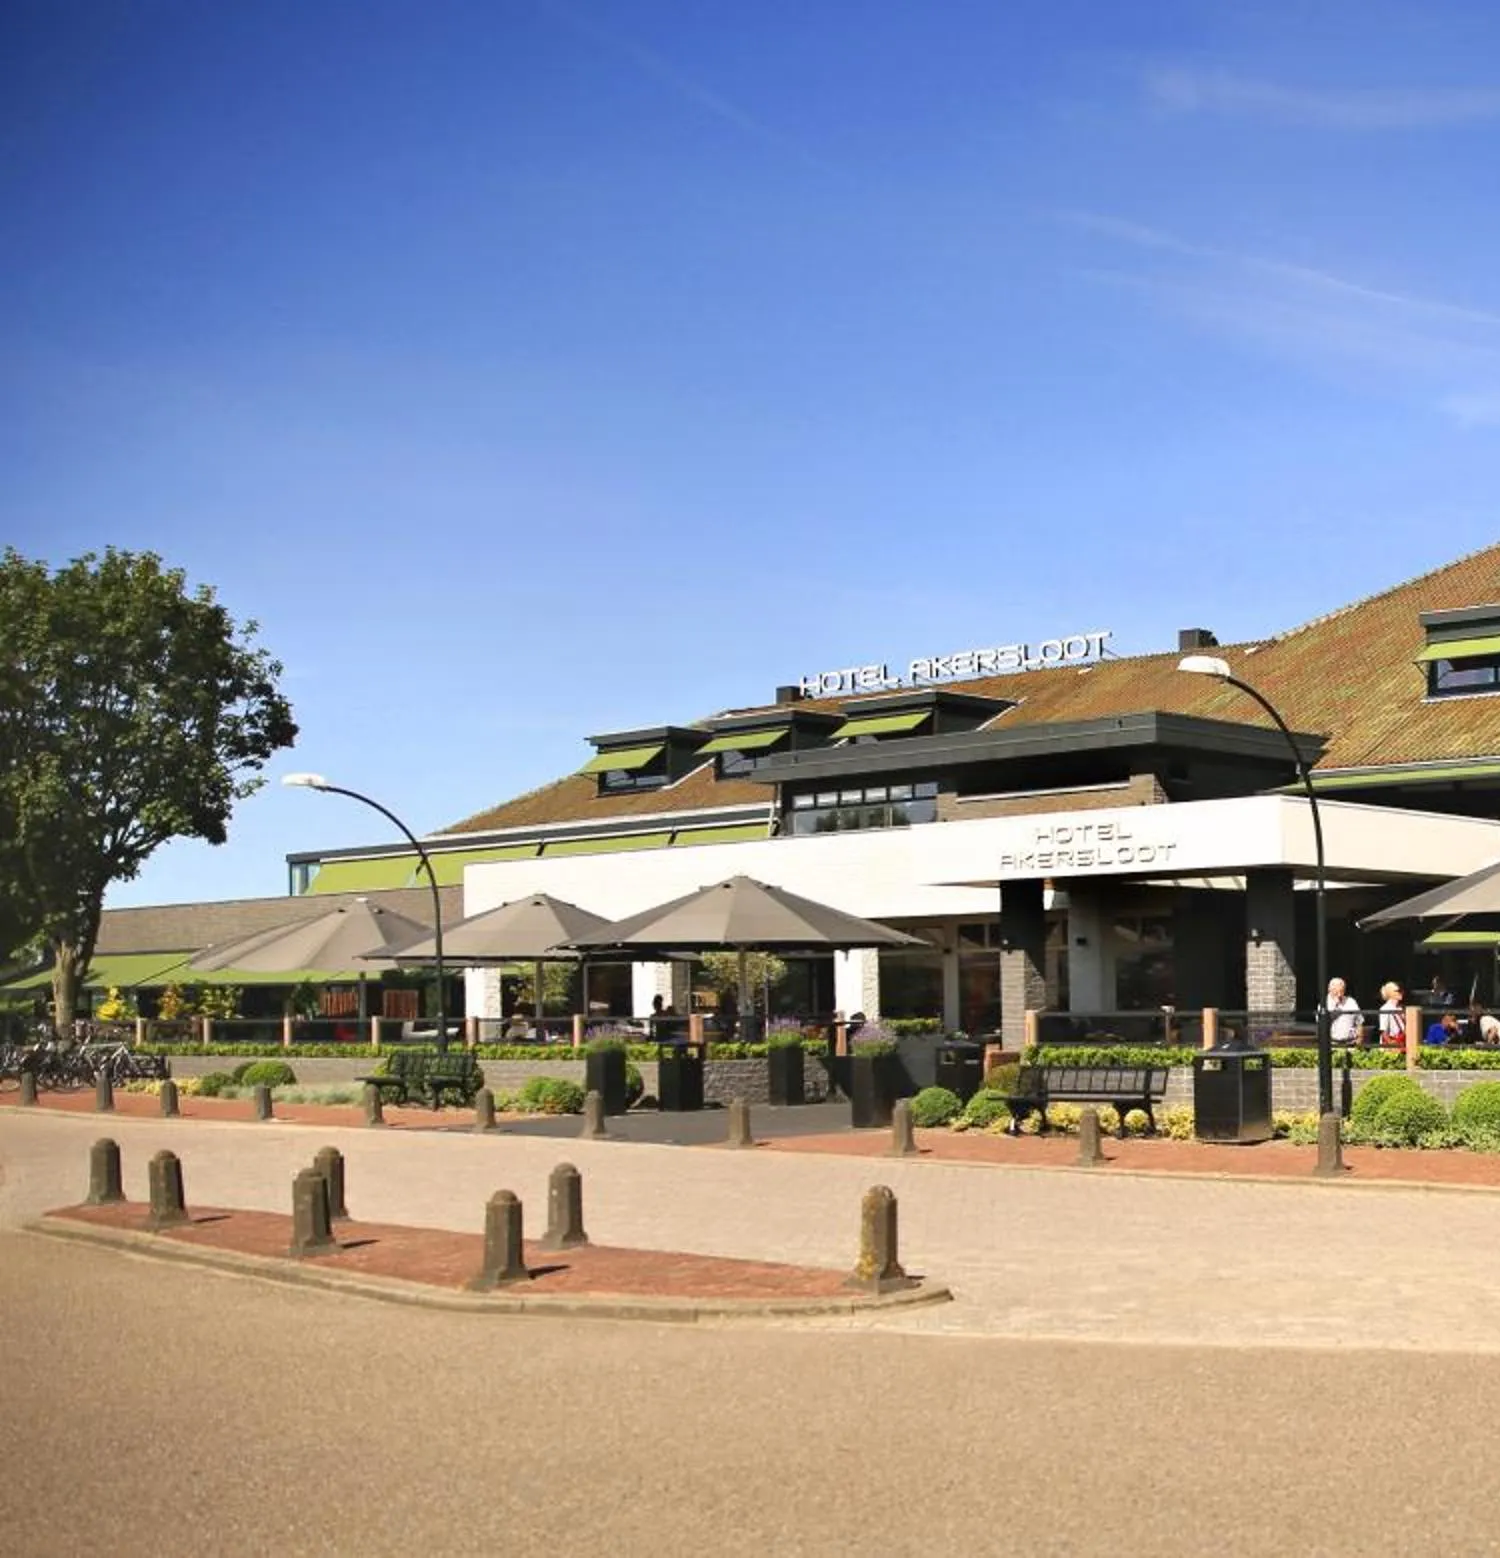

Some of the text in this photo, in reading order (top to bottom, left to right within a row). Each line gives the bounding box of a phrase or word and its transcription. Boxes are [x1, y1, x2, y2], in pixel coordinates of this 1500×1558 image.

[800, 631, 1112, 697] HOTEL AKERSLOOT
[1036, 822, 1132, 844] HOTEL
[1001, 844, 1177, 870] AKERSLOOT
